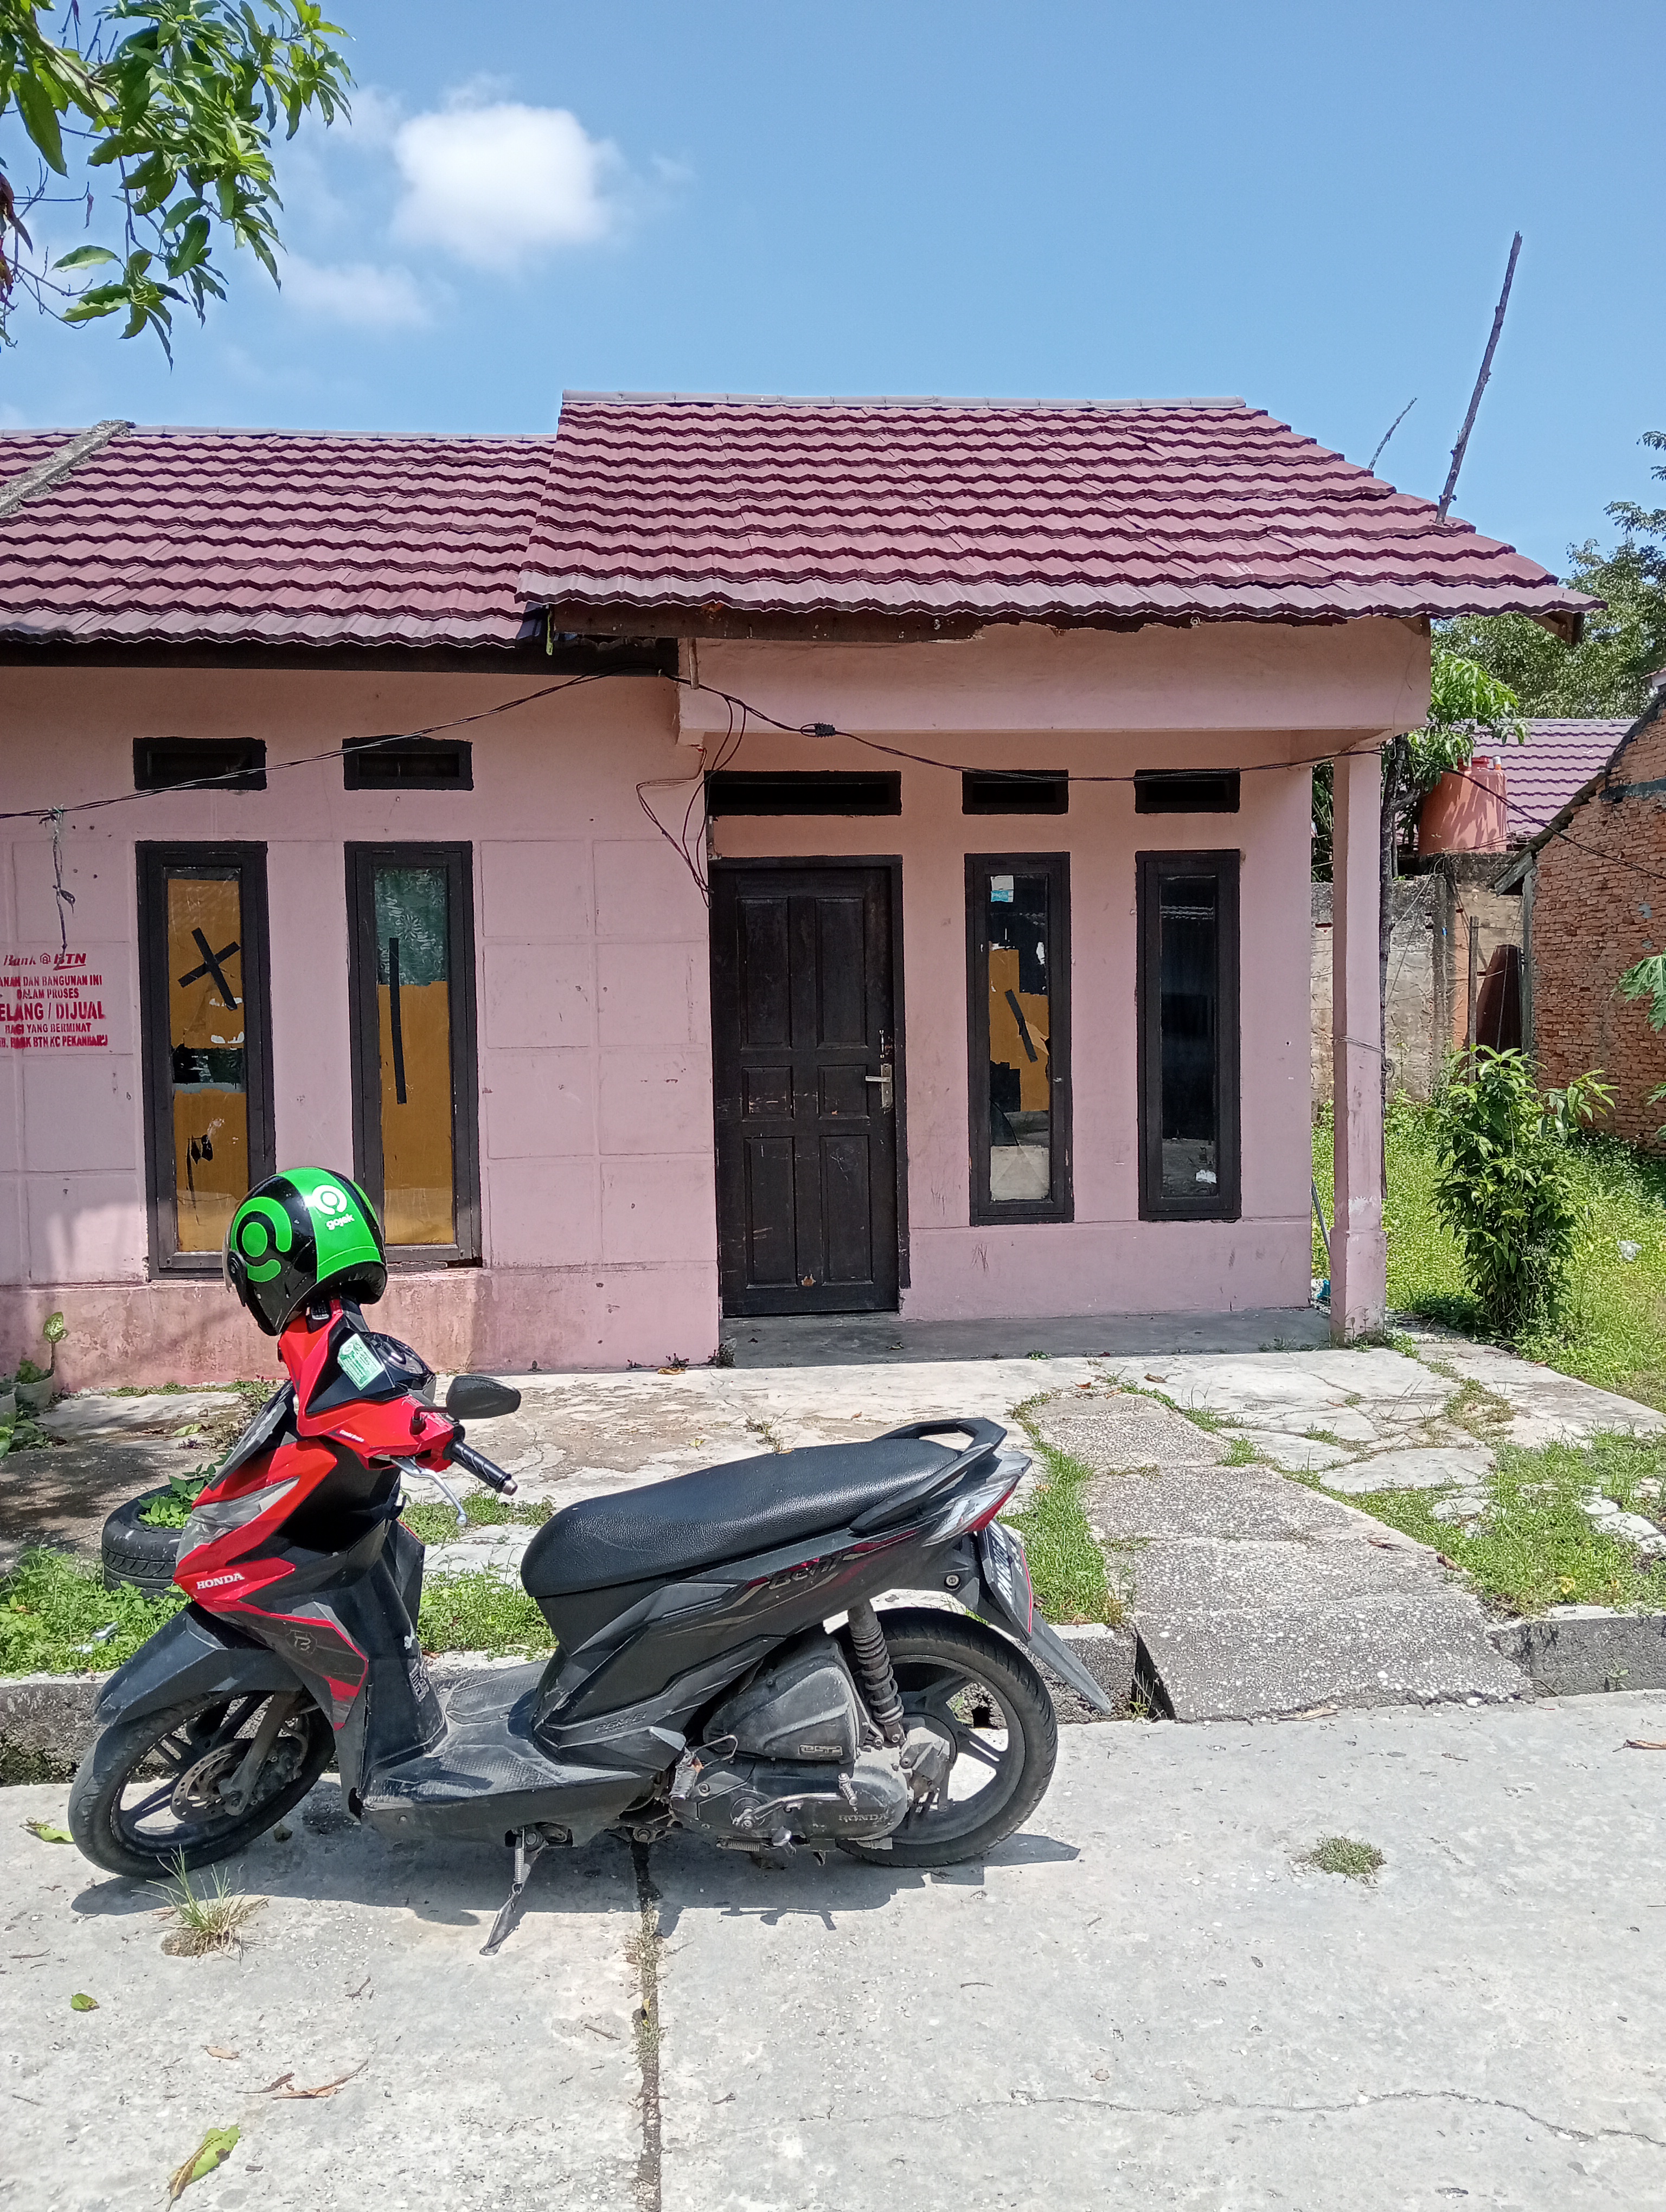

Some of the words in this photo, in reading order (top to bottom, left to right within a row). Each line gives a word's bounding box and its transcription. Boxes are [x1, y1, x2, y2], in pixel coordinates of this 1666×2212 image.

[23, 976, 39, 986] DAN
[42, 975, 87, 986] BANGUNAN
[89, 974, 102, 986] INI
[17, 989, 44, 1000] DALAM
[47, 987, 79, 999] PROSES
[56, 1001, 106, 1020] DIJUAL
[27, 1024, 48, 1033] YANG
[50, 1023, 92, 1032] BERMINAT
[33, 1037, 48, 1047] BTN
[50, 1036, 60, 1047] KC
[326, 1213, 355, 1230] gojek
[196, 1573, 245, 1590] HONDA
[838, 1814, 888, 1822] HONDA
